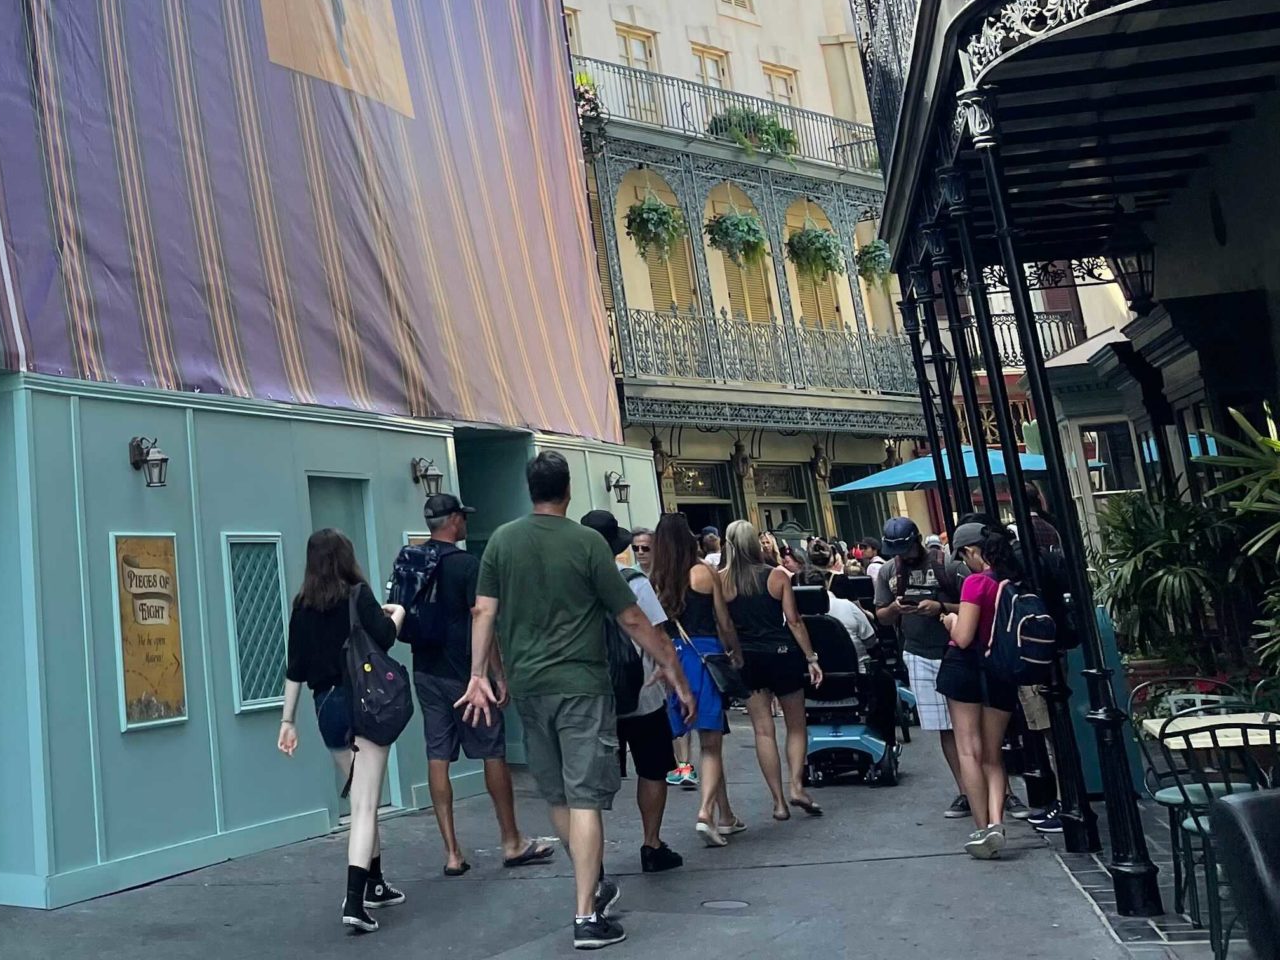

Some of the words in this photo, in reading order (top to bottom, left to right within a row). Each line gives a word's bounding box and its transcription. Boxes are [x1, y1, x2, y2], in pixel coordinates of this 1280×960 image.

[127, 570, 158, 589] PIECES
[159, 576, 170, 590] OF
[138, 602, 165, 621] EIGHT
